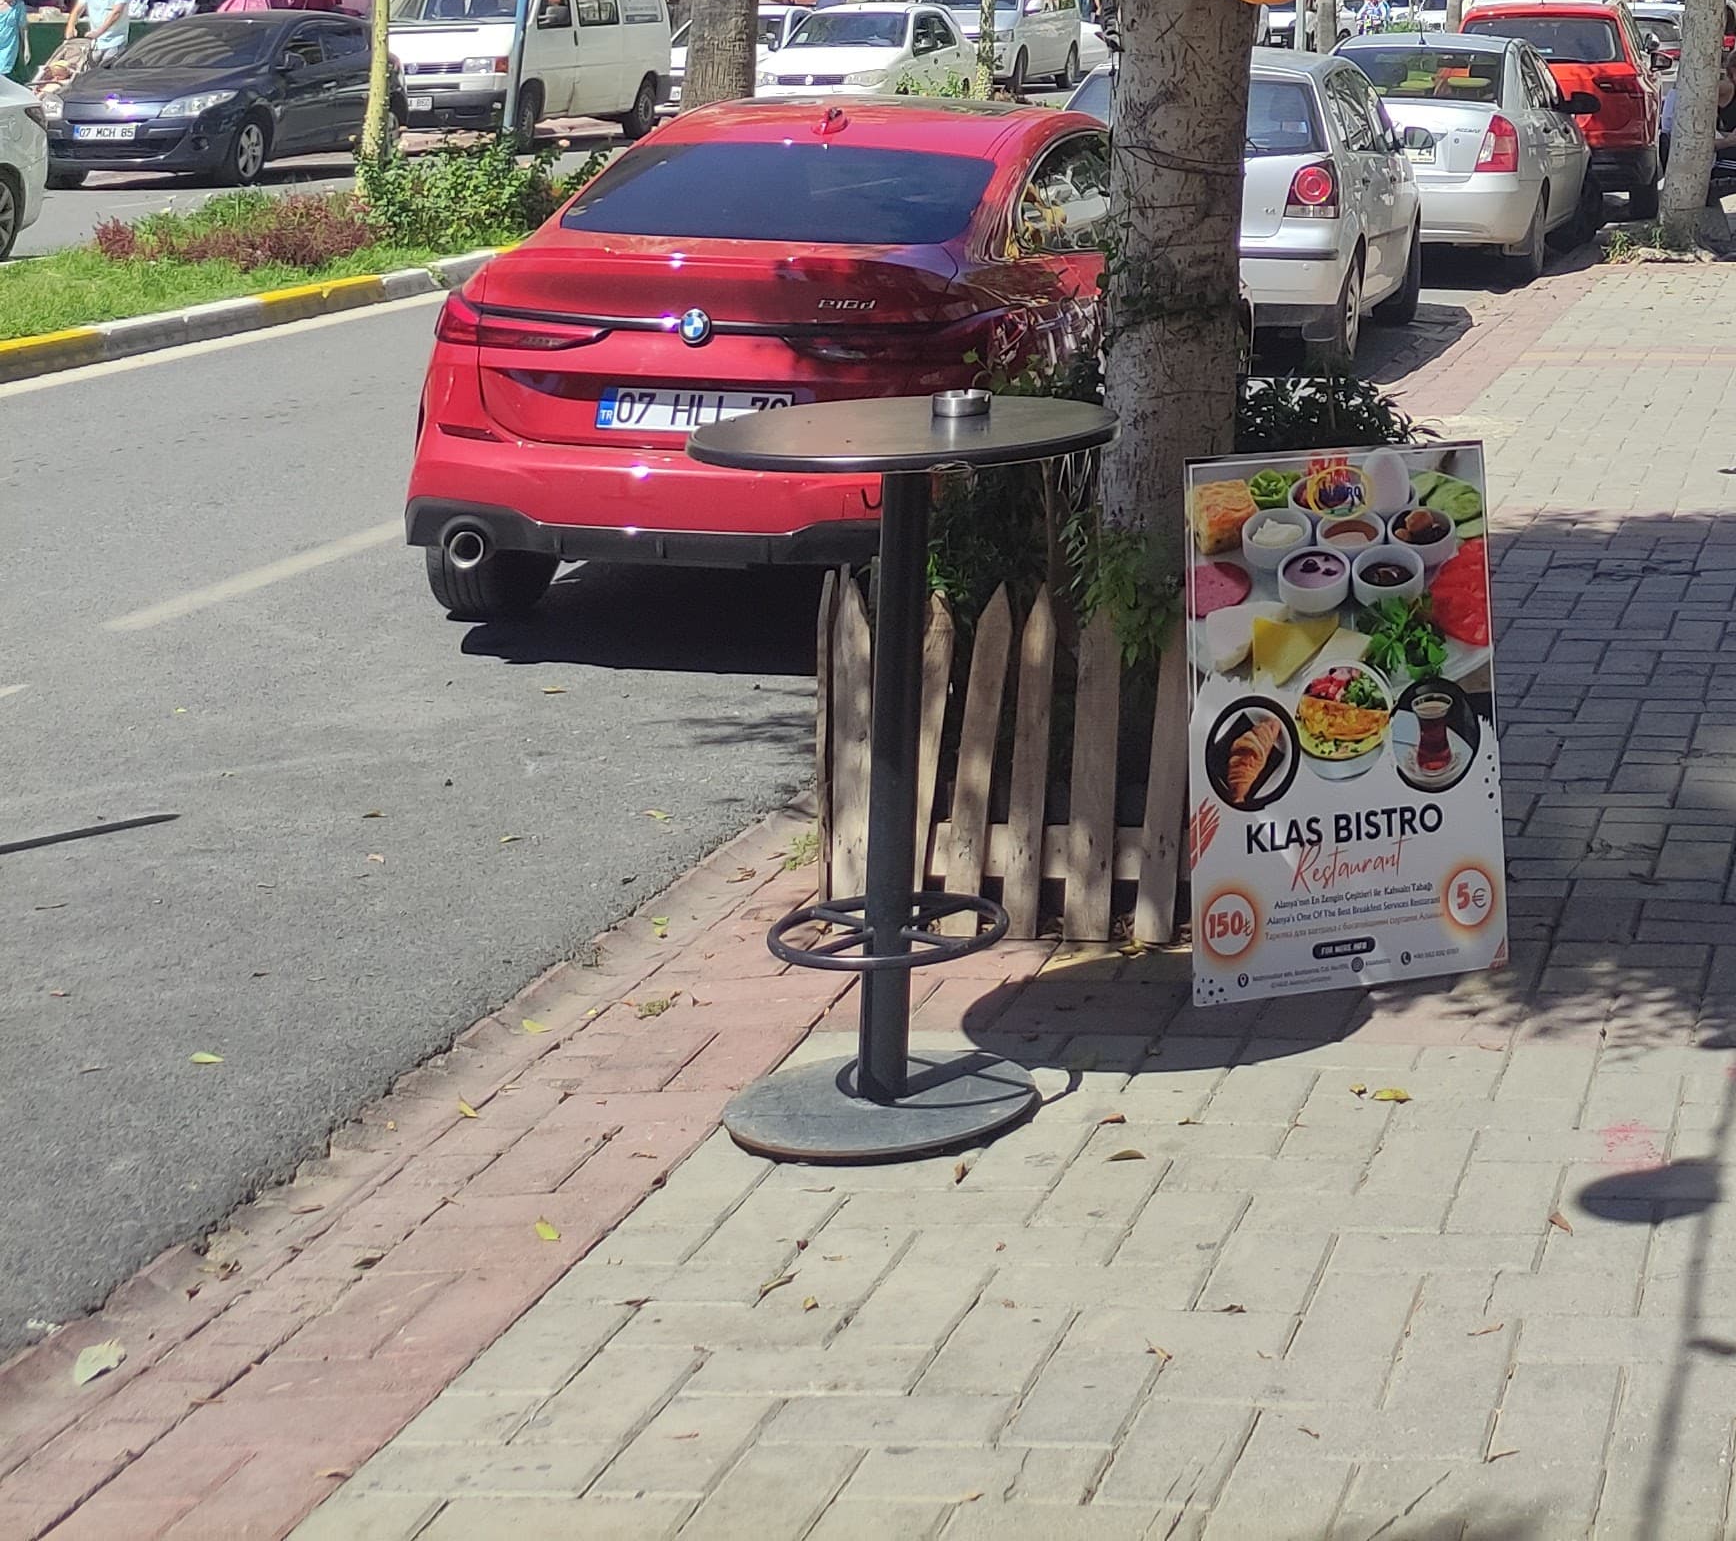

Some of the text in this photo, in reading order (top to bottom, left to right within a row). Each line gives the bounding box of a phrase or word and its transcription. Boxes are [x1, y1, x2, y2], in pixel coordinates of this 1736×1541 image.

[80, 128, 91, 137] 07
[600, 410, 613, 421] TR
[617, 392, 656, 425] 07
[1246, 803, 1443, 855] KLAS BISTRO
[1291, 836, 1413, 893] Restaurant
[1296, 911, 1311, 921] One
[1312, 910, 1322, 919] Of
[1324, 908, 1336, 917] The
[1338, 906, 1350, 916] Best
[1383, 898, 1408, 910] Services
[1456, 882, 1487, 910] 5€
